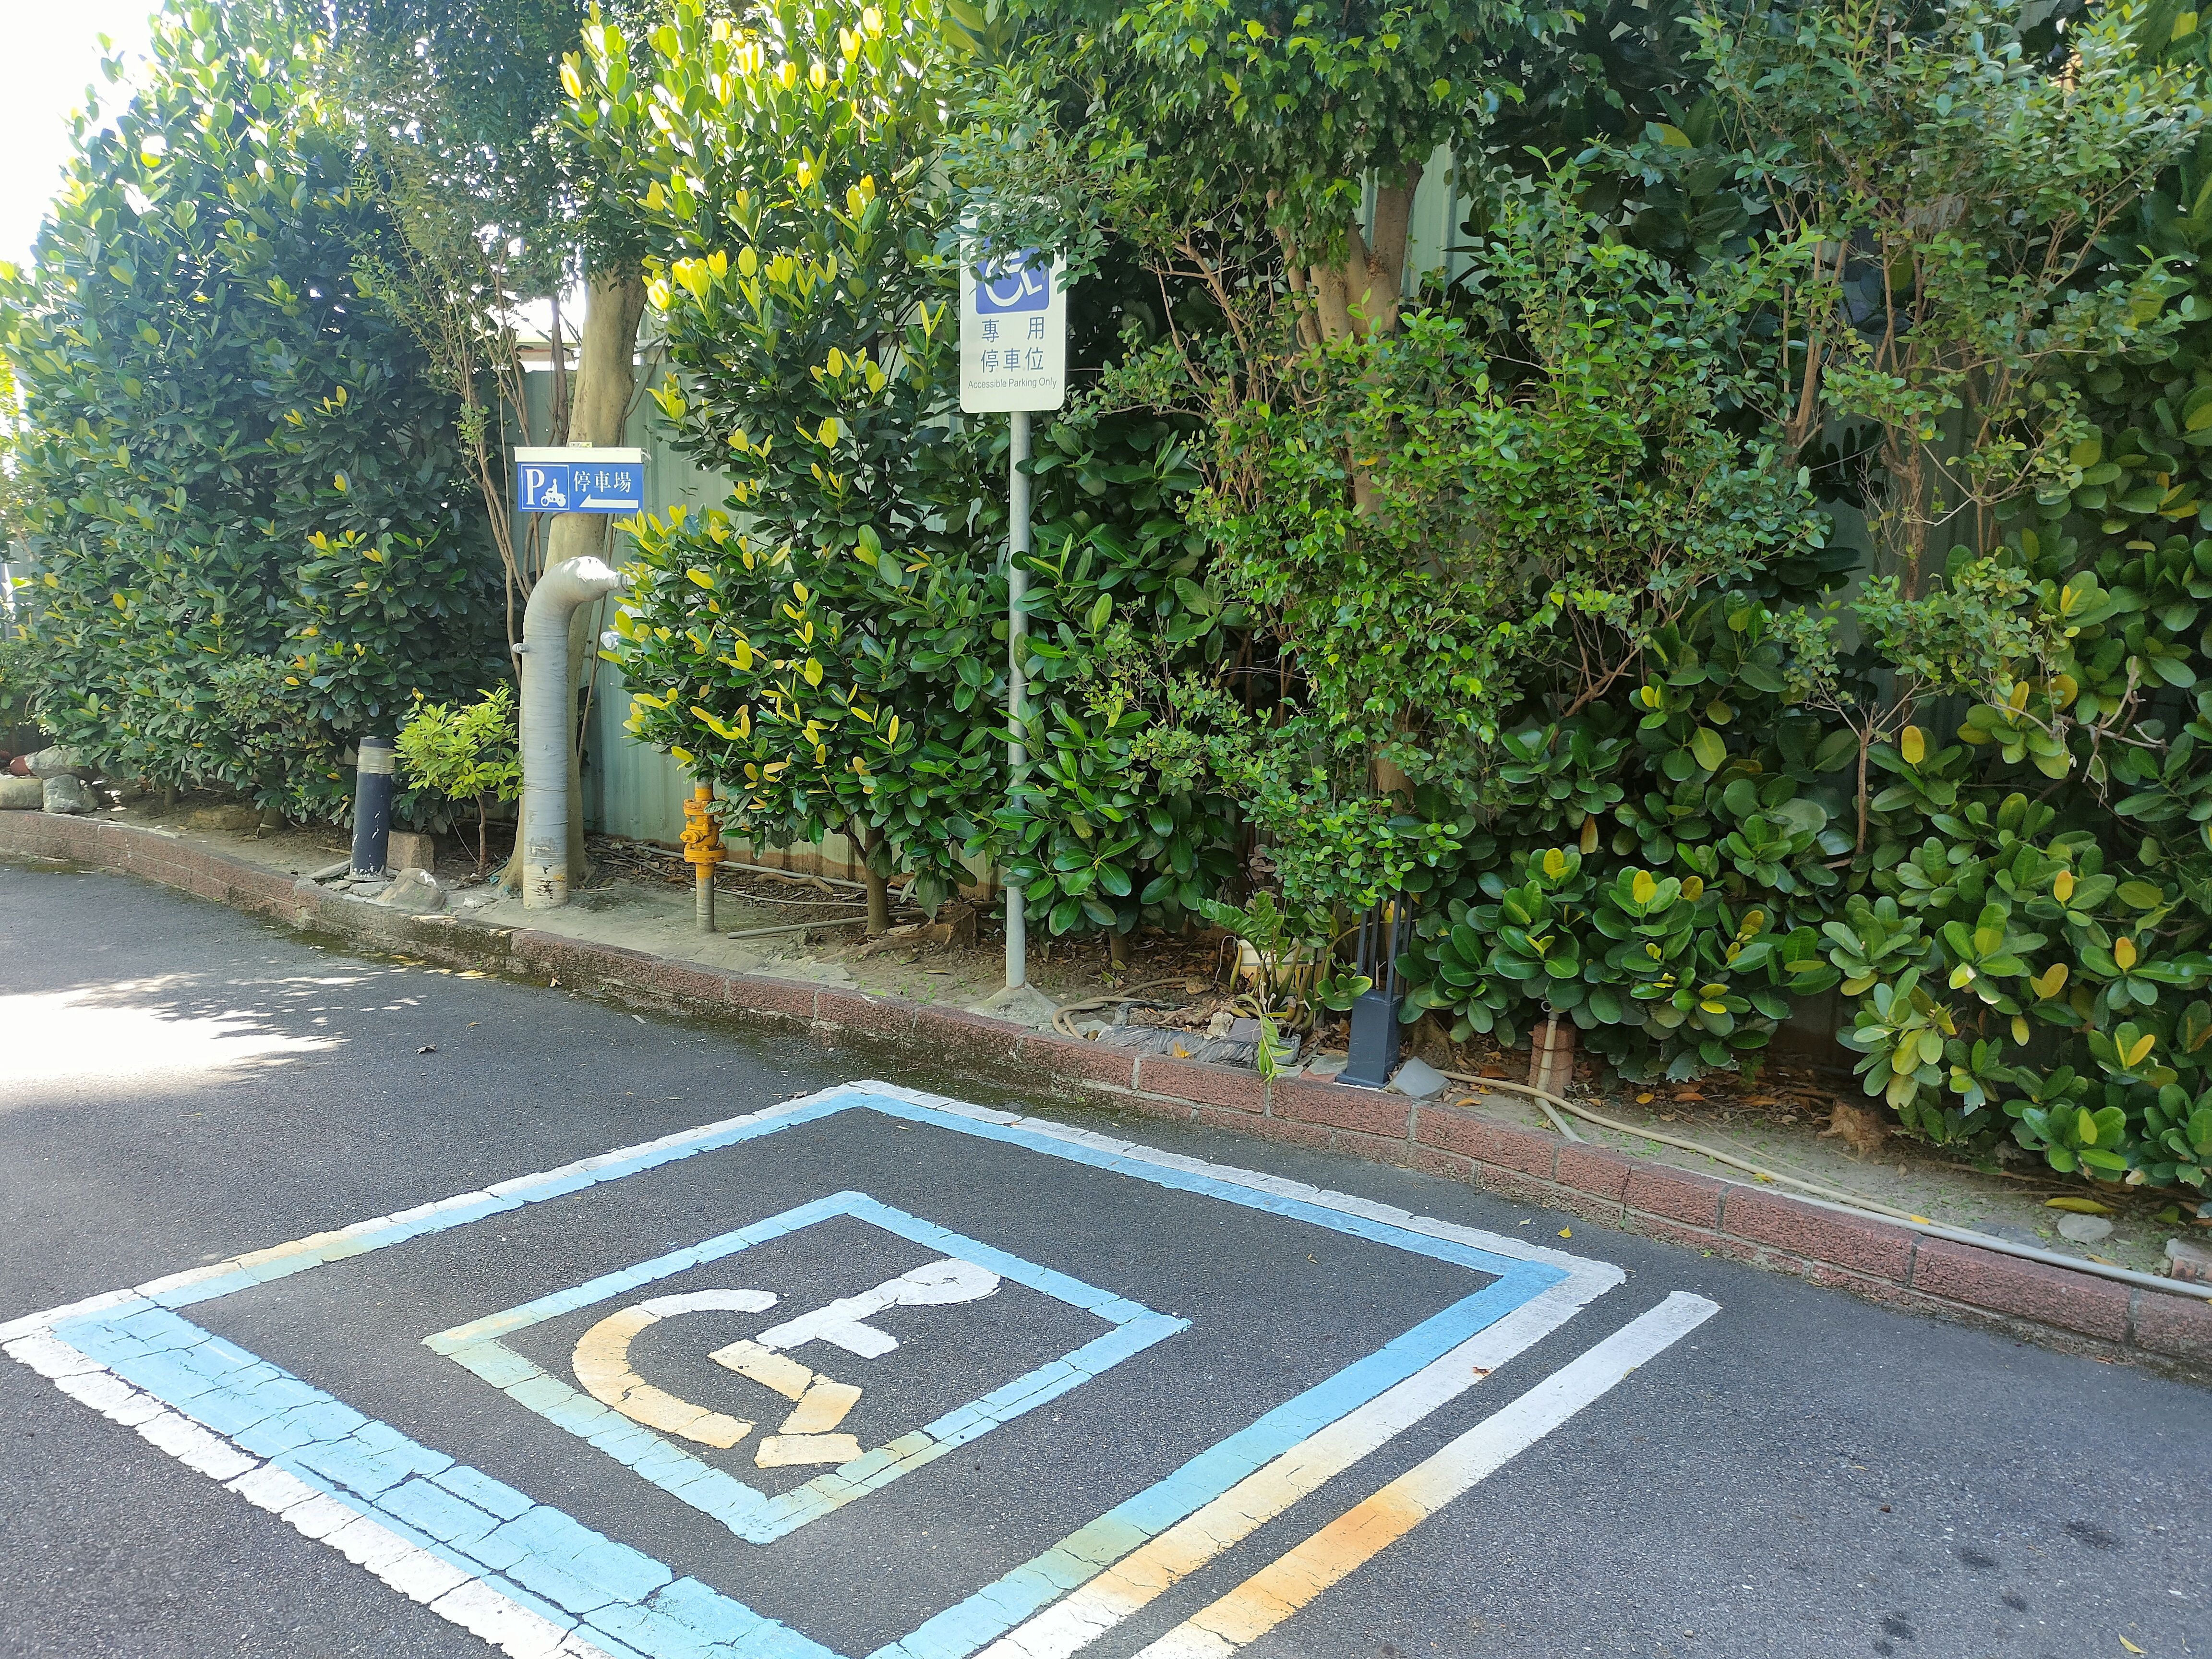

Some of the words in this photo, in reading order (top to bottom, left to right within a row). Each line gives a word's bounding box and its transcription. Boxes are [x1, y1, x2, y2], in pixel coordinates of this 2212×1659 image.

[980, 347, 1044, 373] 停車位
[968, 379, 1007, 389] Accessible
[1009, 378, 1037, 388] Parking
[1039, 377, 1057, 389] Only
[525, 469, 545, 505] P
[573, 470, 631, 493] 停車場
